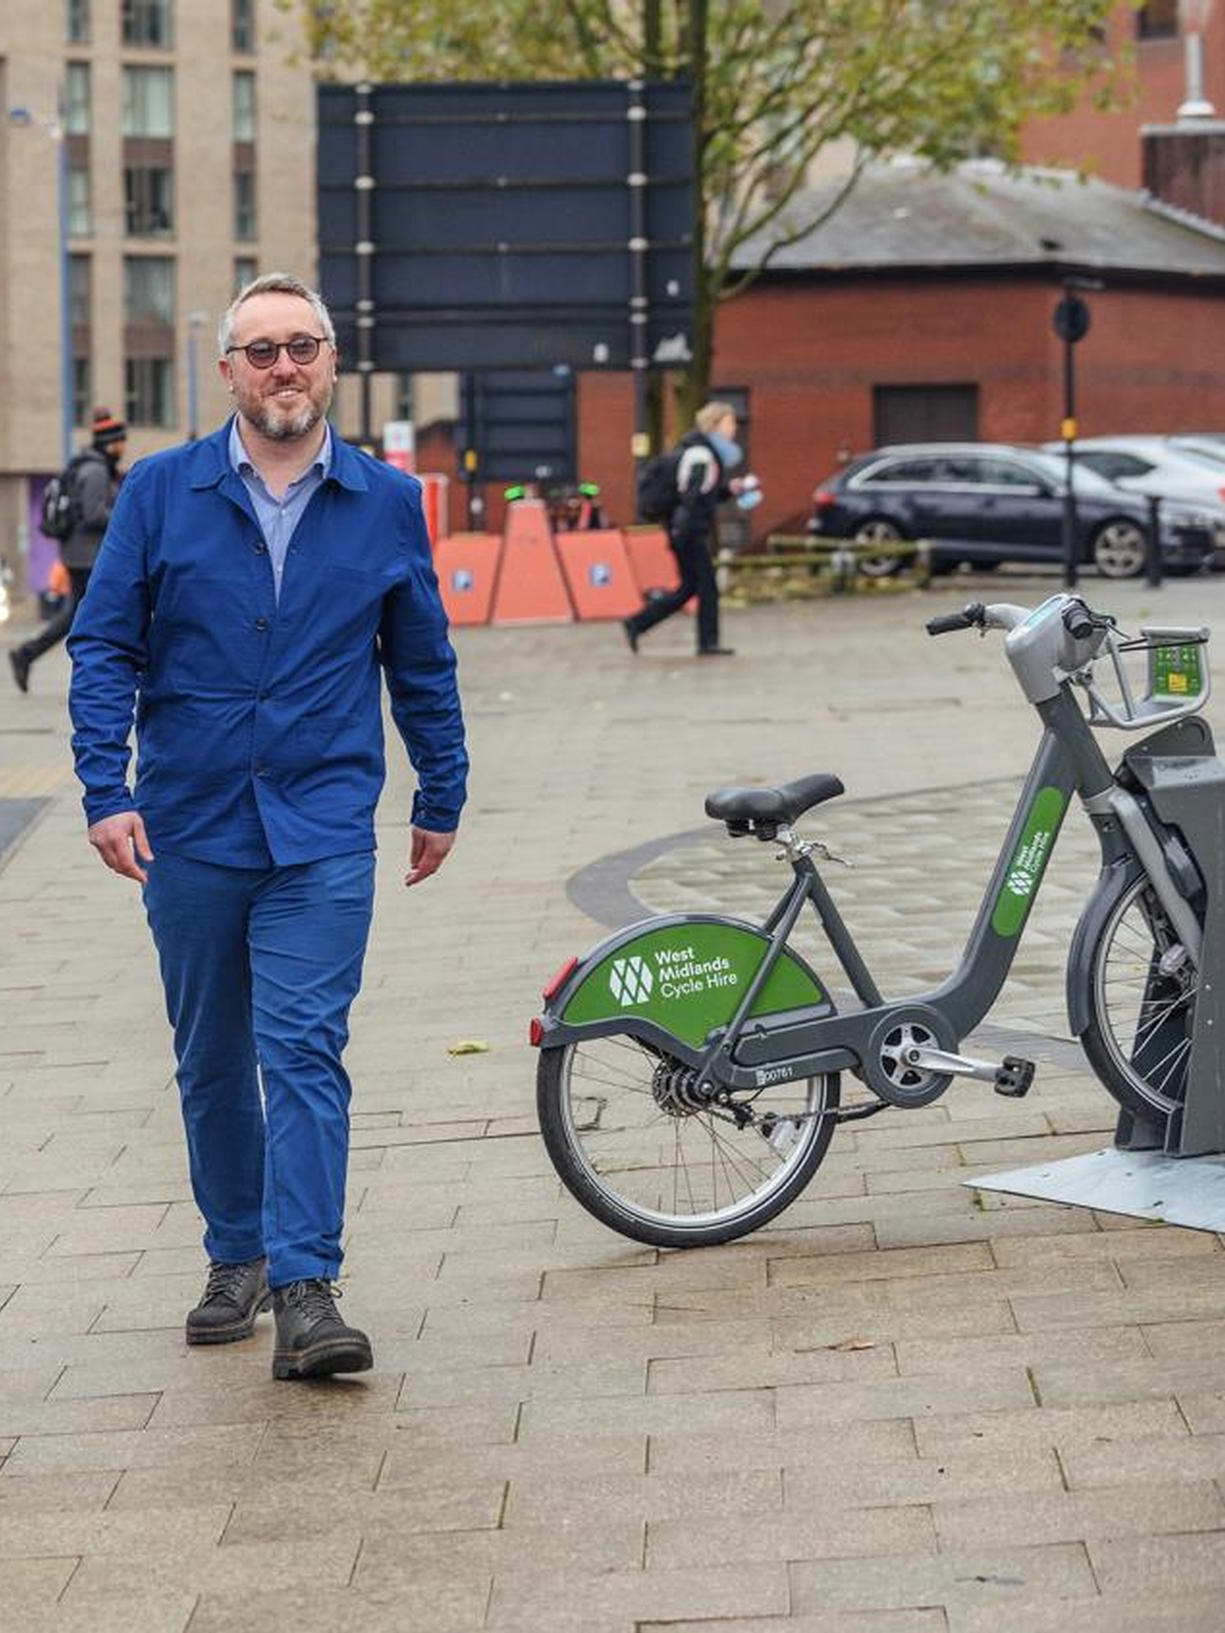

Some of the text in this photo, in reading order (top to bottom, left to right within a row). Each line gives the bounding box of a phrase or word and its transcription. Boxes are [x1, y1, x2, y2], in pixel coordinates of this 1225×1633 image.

[654, 946, 695, 965] West
[658, 956, 730, 982] Midlands
[660, 973, 738, 999] Cycle Hire
